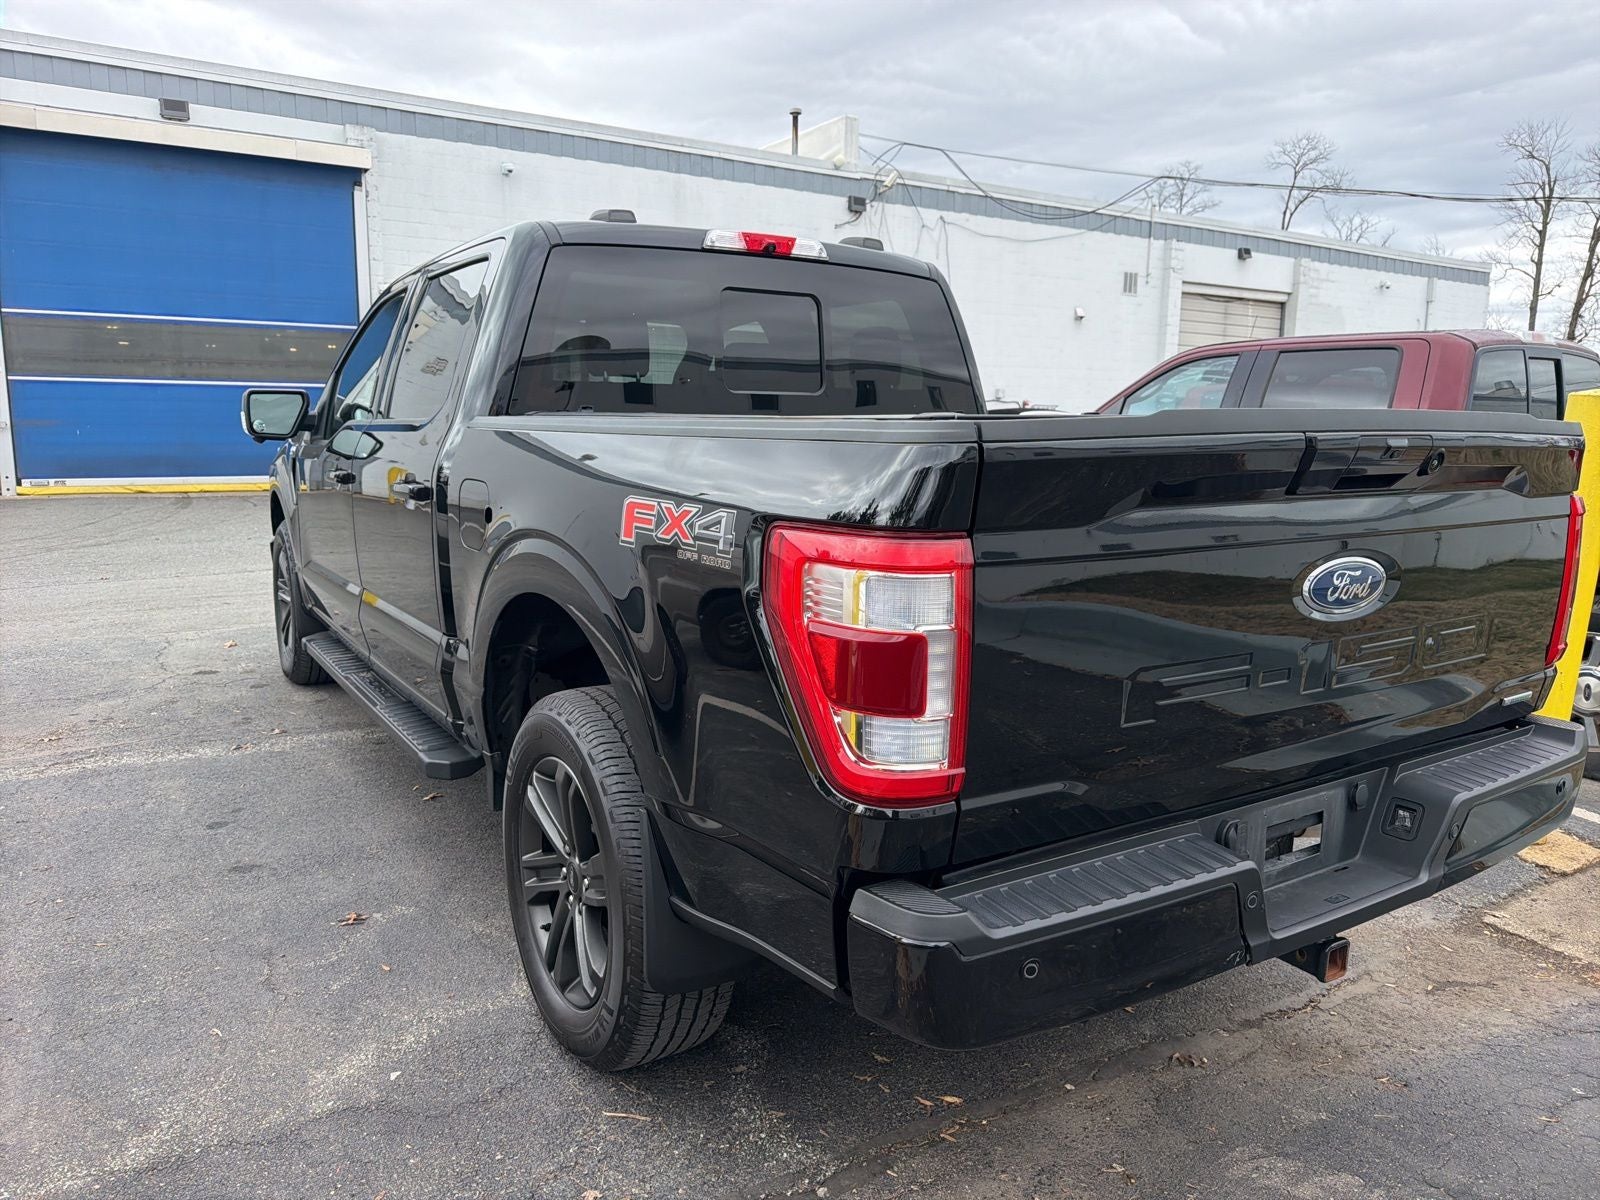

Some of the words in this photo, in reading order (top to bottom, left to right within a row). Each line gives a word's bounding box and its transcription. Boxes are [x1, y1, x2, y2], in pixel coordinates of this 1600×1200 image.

[619, 495, 737, 558] FX4
[677, 549, 698, 561] OFF
[700, 554, 732, 569] ROAD
[1327, 569, 1372, 602] Ford
[1120, 614, 1489, 728] F-150
